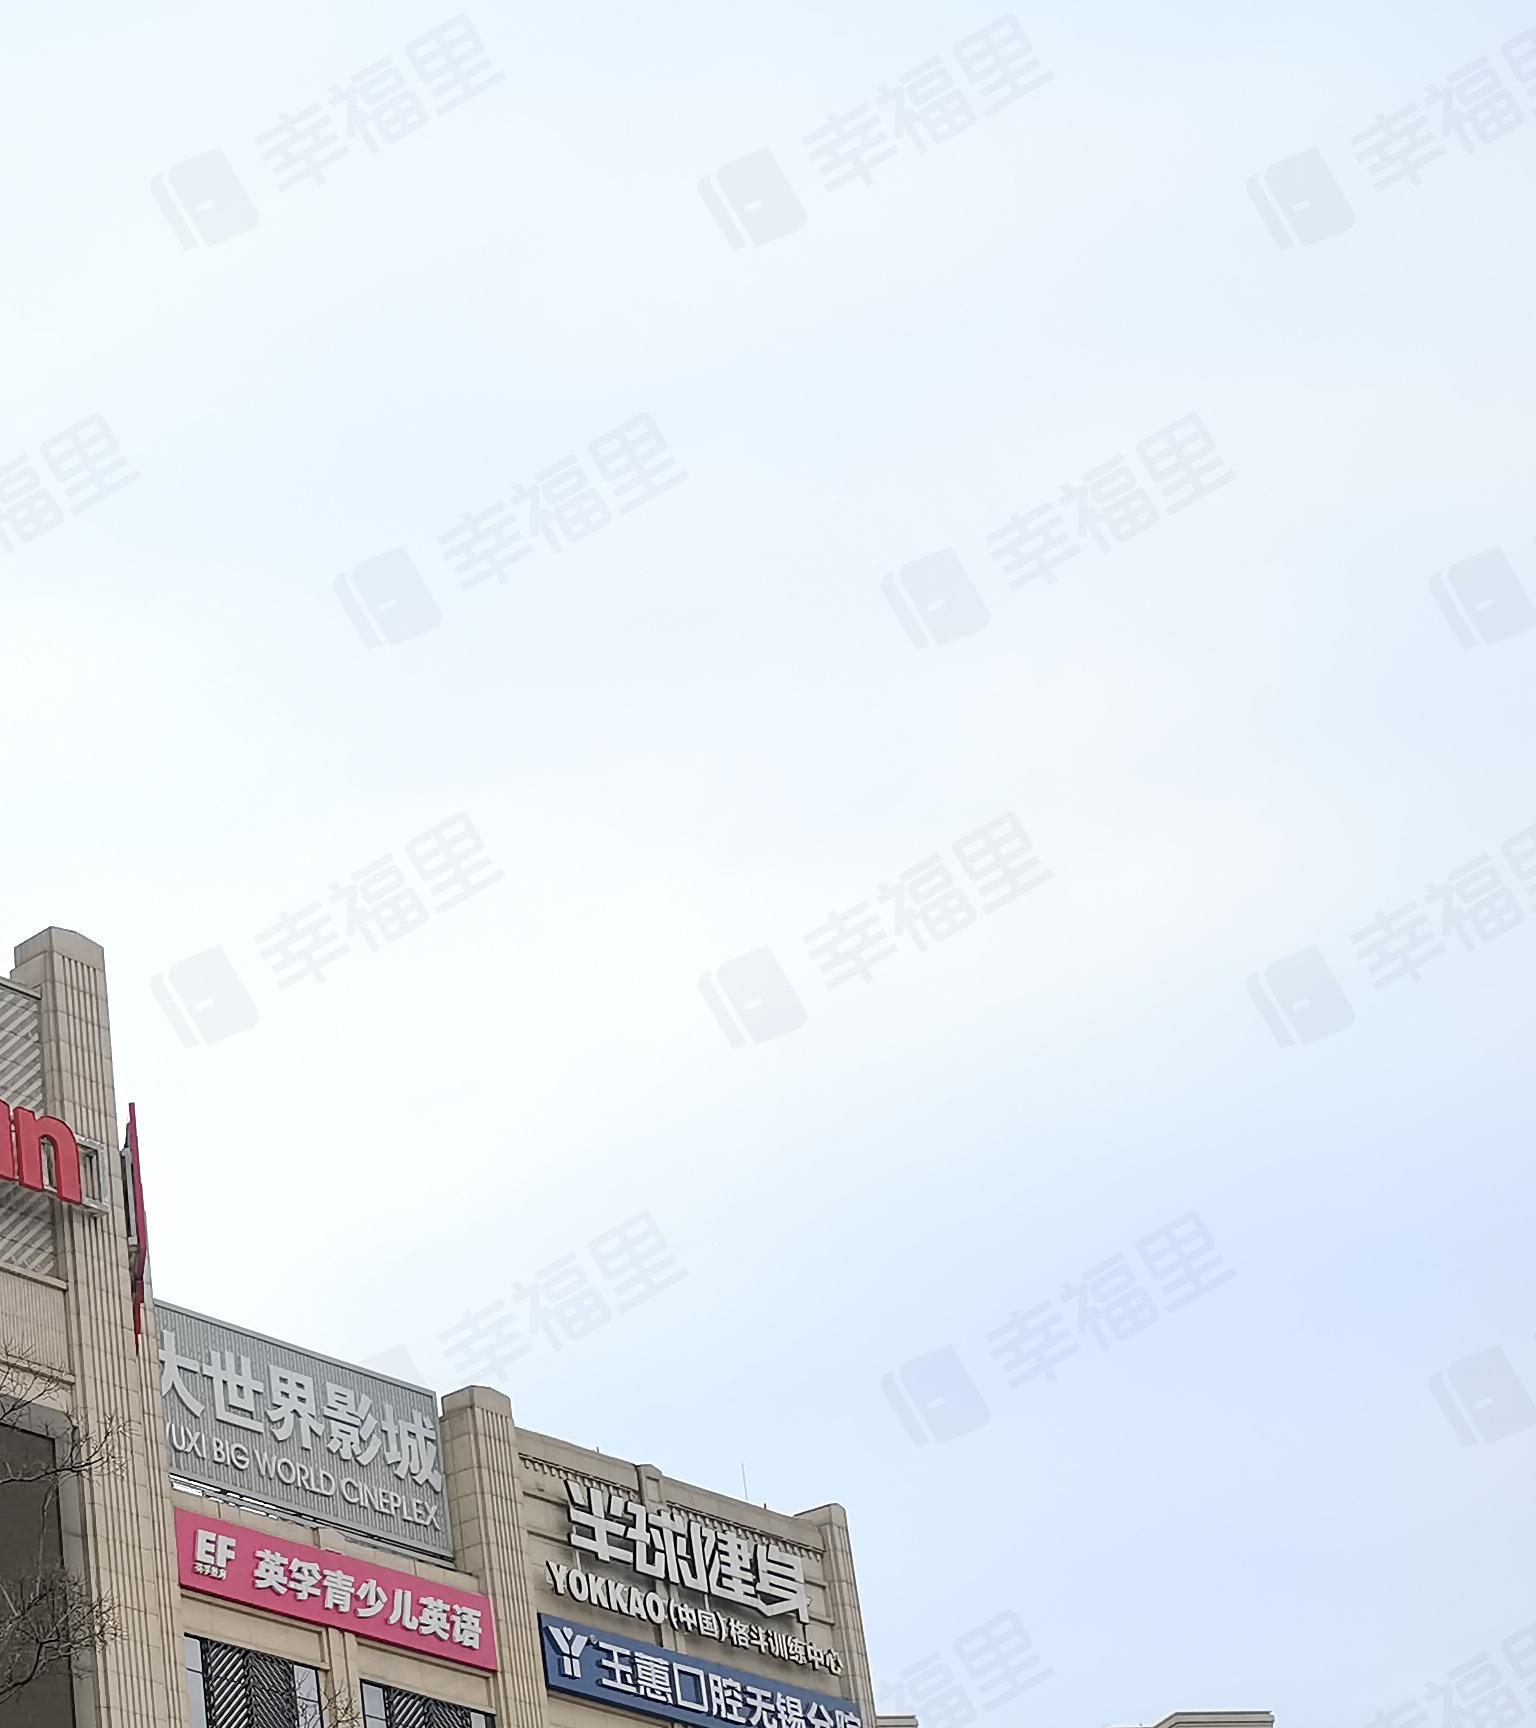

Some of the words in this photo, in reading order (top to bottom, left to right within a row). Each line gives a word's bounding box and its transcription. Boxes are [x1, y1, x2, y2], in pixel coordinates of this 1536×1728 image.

[158, 1328, 443, 1494] 大世界影城
[165, 1421, 207, 1460] UXI
[212, 1437, 251, 1472] BIG
[254, 1448, 336, 1498] WORLD
[340, 1475, 442, 1532] CINEPLEX
[193, 1528, 237, 1569] EF
[253, 1548, 483, 1651] 英孚青少儿英语
[544, 1560, 667, 1626] YOKKAO
